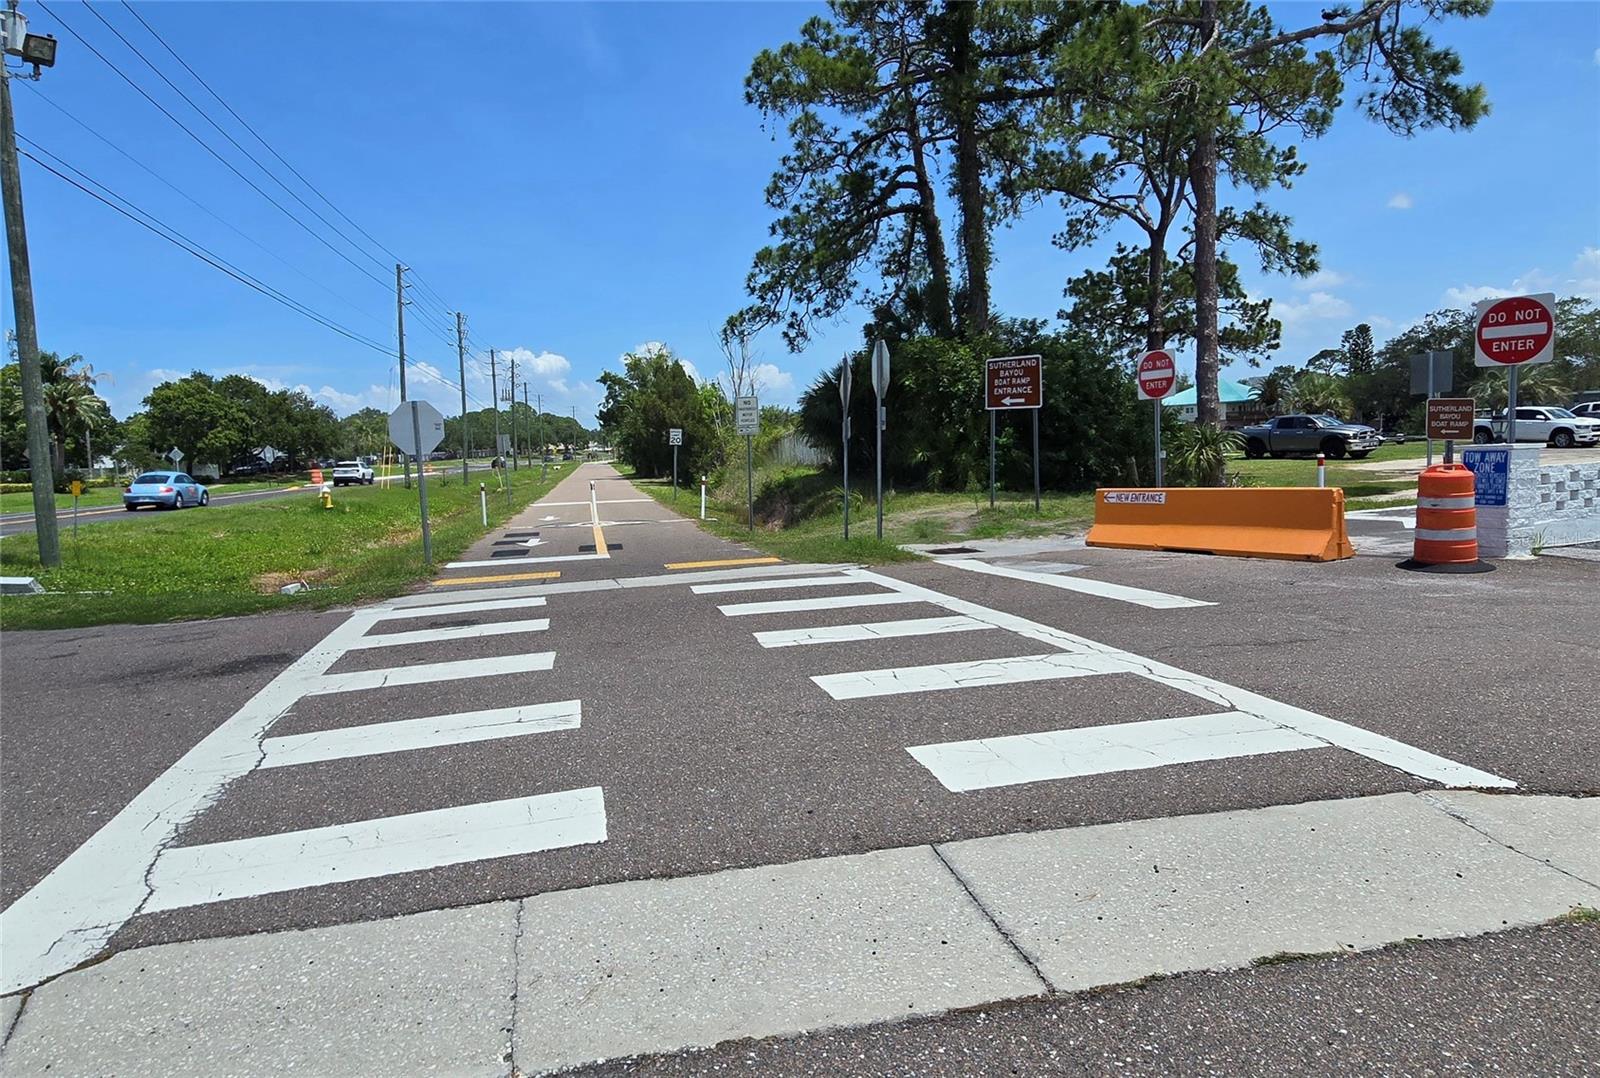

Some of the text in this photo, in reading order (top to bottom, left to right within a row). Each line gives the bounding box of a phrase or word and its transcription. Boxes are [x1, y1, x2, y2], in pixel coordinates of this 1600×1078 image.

[1488, 308, 1542, 324] DO NOT
[1492, 339, 1535, 352] ENTER
[988, 359, 1037, 370] SUTHERLAND
[1143, 358, 1170, 370] DO NOT
[1000, 369, 1024, 378] BAYOU
[994, 377, 1031, 386] BOAT RAMP
[1146, 380, 1168, 390] ENTER
[993, 386, 1033, 395] ENTRANCE
[1429, 405, 1473, 413] SUTHERLAND
[671, 436, 681, 444] 20
[1465, 451, 1507, 463] TOW AWAY
[1474, 462, 1496, 473] ZONE
[1116, 493, 1163, 502] NEW ENTRANCE
